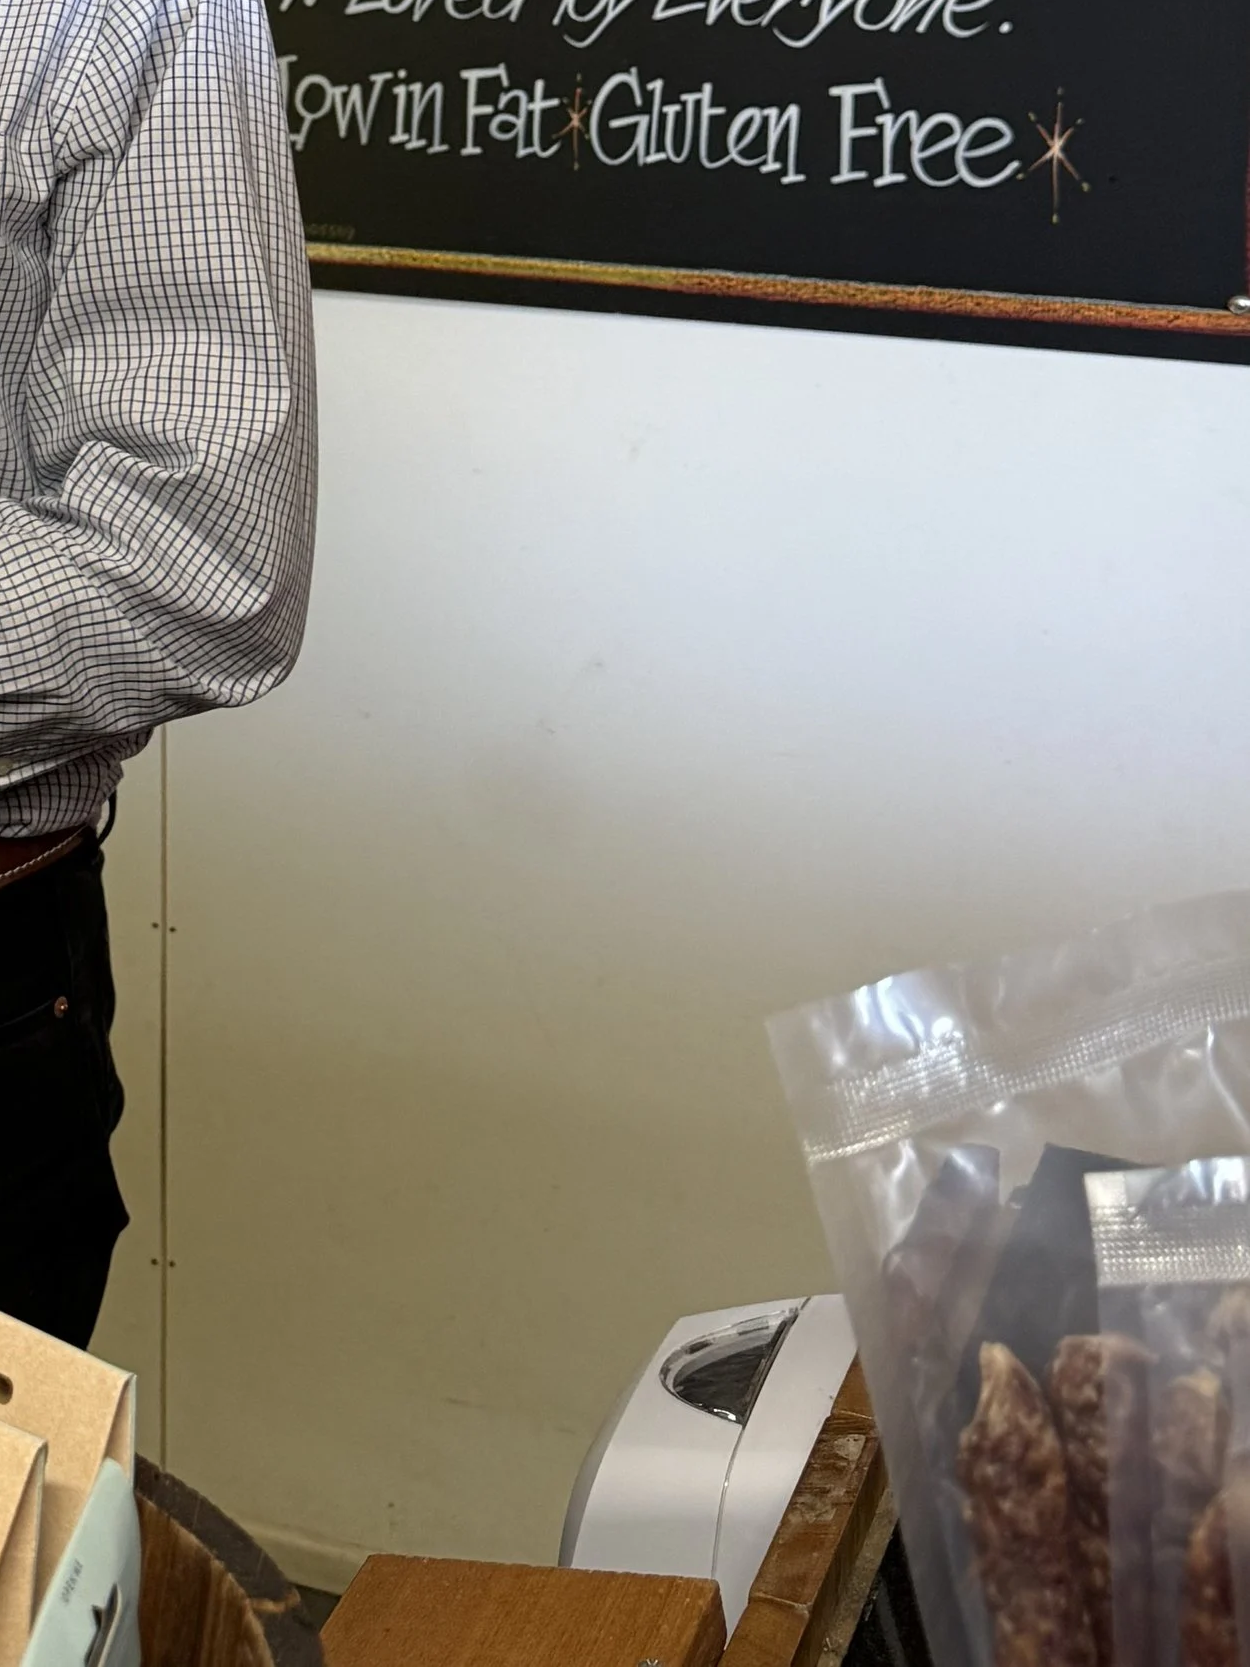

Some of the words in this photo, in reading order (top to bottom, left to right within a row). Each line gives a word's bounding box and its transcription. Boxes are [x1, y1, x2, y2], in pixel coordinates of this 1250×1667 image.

[389, 68, 449, 154] in
[460, 62, 562, 159] Fat
[590, 66, 806, 185] Gluten
[829, 77, 1021, 188] Free
